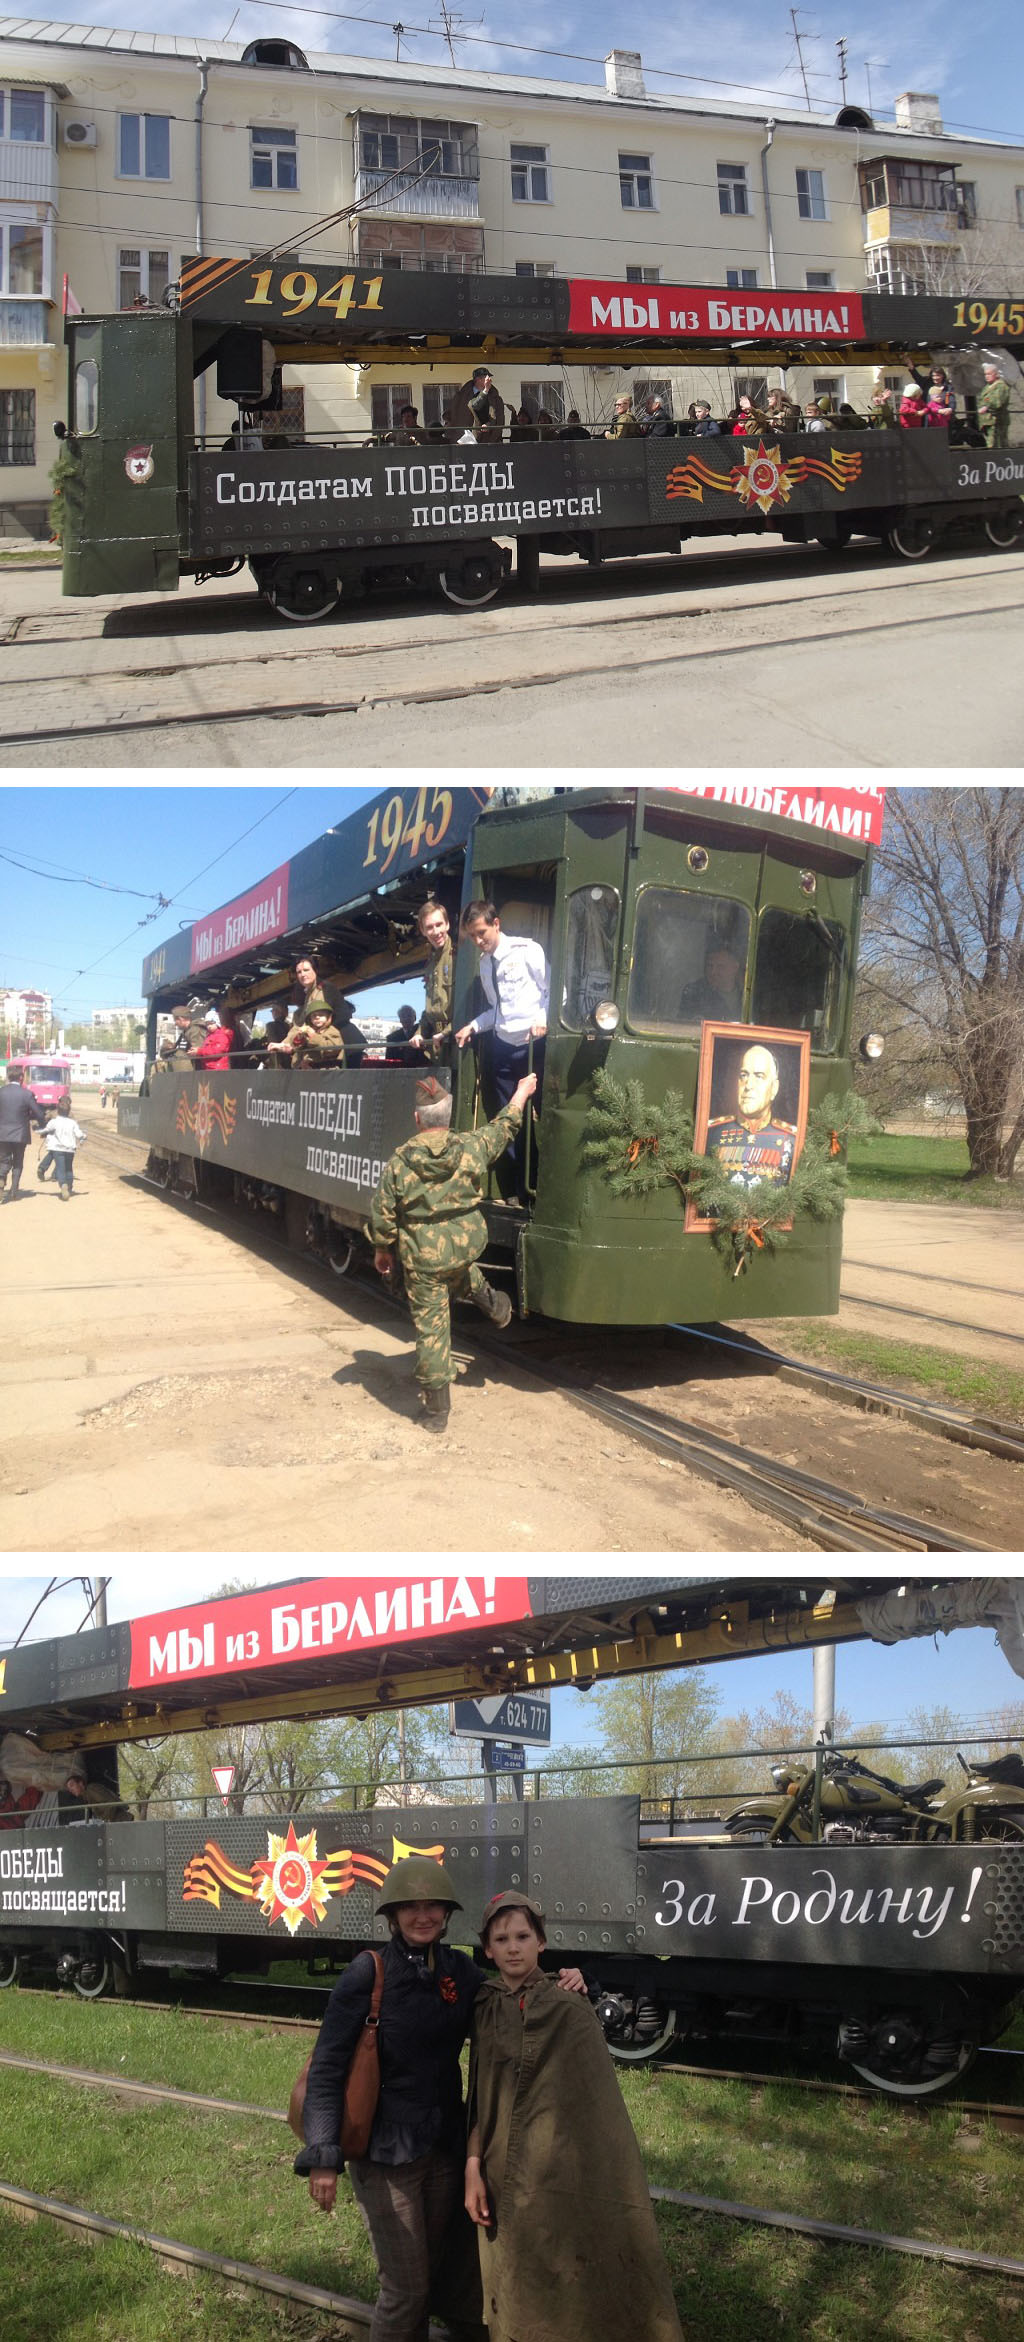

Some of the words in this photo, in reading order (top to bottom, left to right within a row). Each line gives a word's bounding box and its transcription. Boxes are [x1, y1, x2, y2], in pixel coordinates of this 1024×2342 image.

[244, 269, 385, 320] 1941
[590, 295, 660, 330] МЫ
[669, 311, 700, 331] из
[707, 300, 850, 334] БЕРЛИНА!
[952, 301, 1024, 336] 1945
[216, 472, 373, 507] Солдатам
[384, 461, 515, 500] ПОБЕДЫ
[957, 463, 981, 488] За
[411, 487, 602, 527] посвящается!
[362, 787, 453, 874] 1945
[195, 927, 213, 965] МЫ
[213, 934, 224, 957] из
[246, 1087, 296, 1128] Солдатам
[298, 1090, 363, 1142] ПОБЕДЫ
[148, 1621, 216, 1678] МЫ
[225, 1631, 261, 1664] из
[507, 1701, 528, 1729] 624
[530, 1705, 548, 1732] 777
[2, 1880, 126, 1916] посвящается!
[654, 1878, 717, 1928] За
[731, 1866, 984, 1940] Родину!
